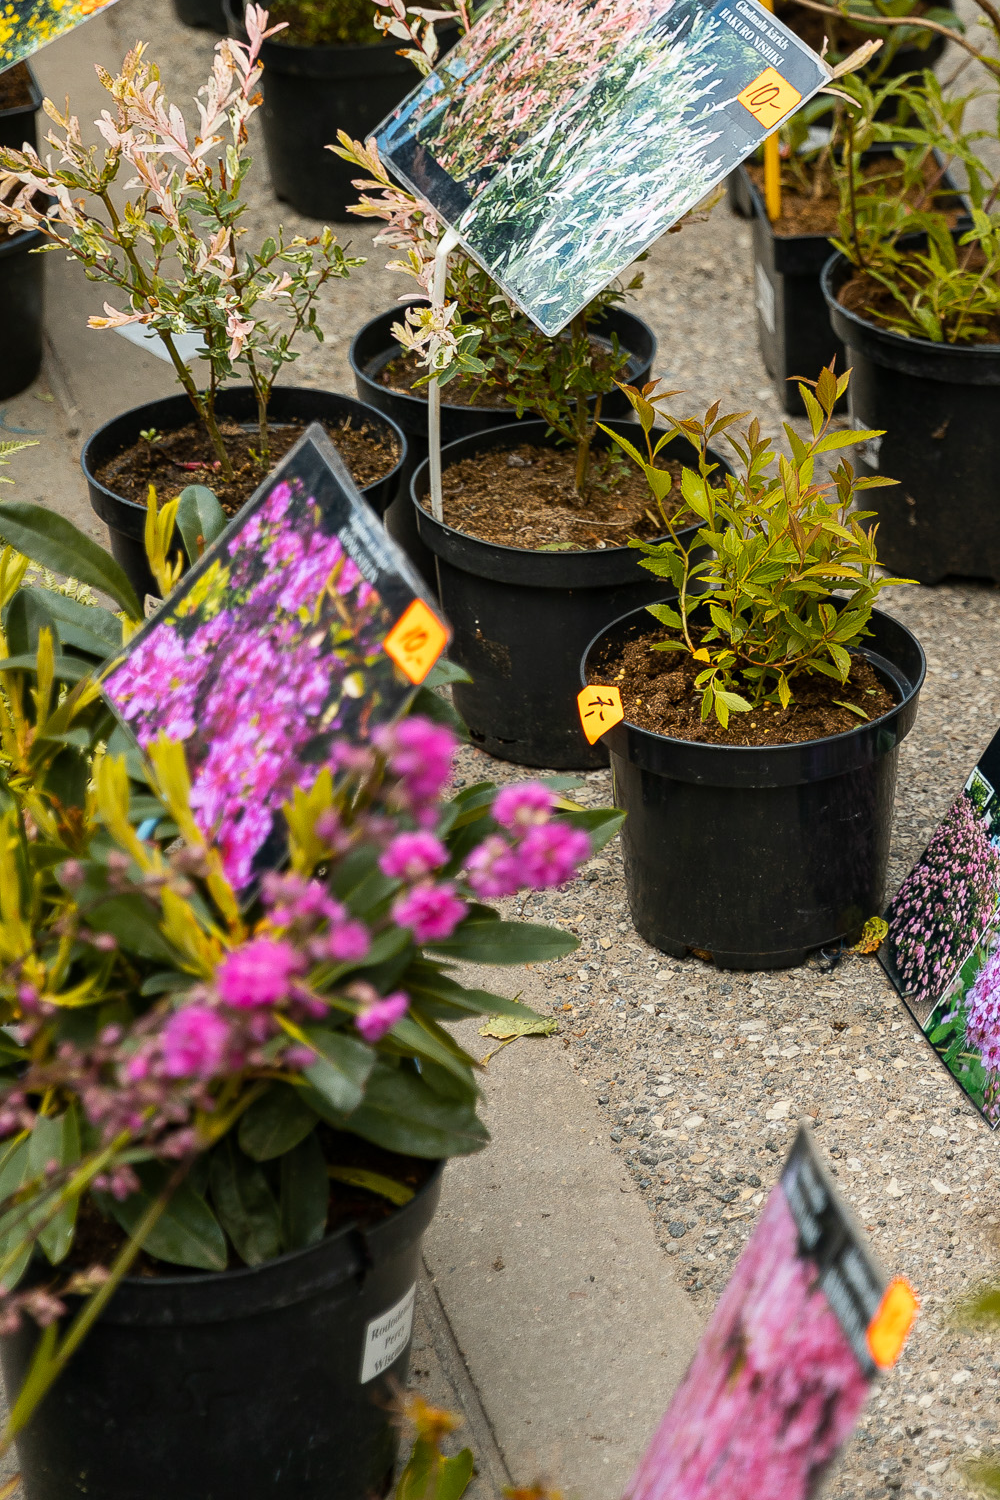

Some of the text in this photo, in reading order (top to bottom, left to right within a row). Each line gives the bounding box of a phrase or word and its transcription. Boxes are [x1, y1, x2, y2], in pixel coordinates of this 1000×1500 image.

[718, 7, 785, 67] HAKURO NISHIKI
[765, 28, 790, 51] kārkls
